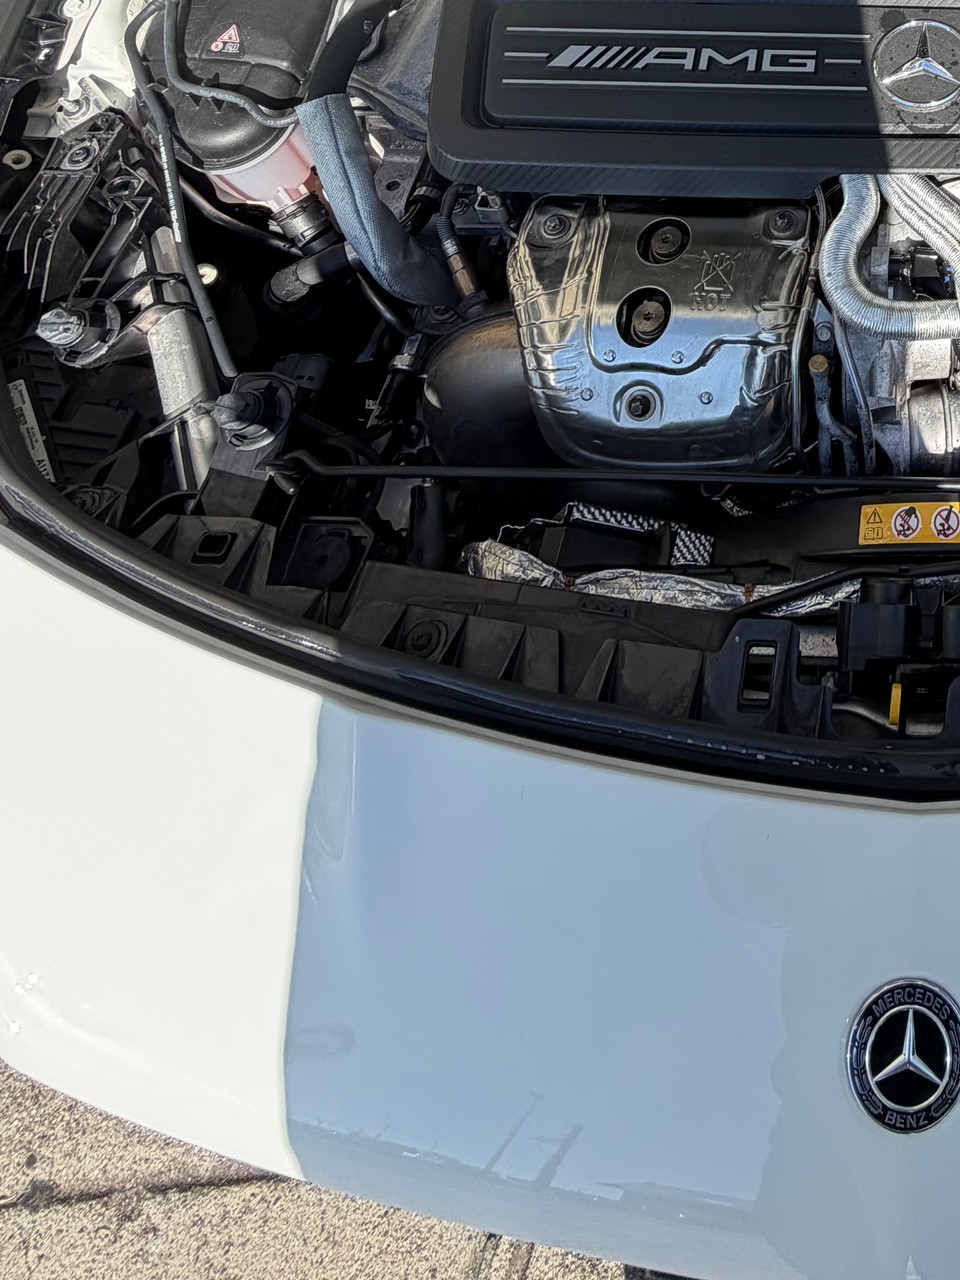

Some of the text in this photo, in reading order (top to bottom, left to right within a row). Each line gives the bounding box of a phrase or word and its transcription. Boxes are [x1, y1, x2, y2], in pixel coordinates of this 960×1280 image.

[632, 46, 817, 73] AMG
[689, 292, 731, 311] HOT
[872, 987, 951, 1020] MERCEDES
[884, 1111, 929, 1128] BENZ
